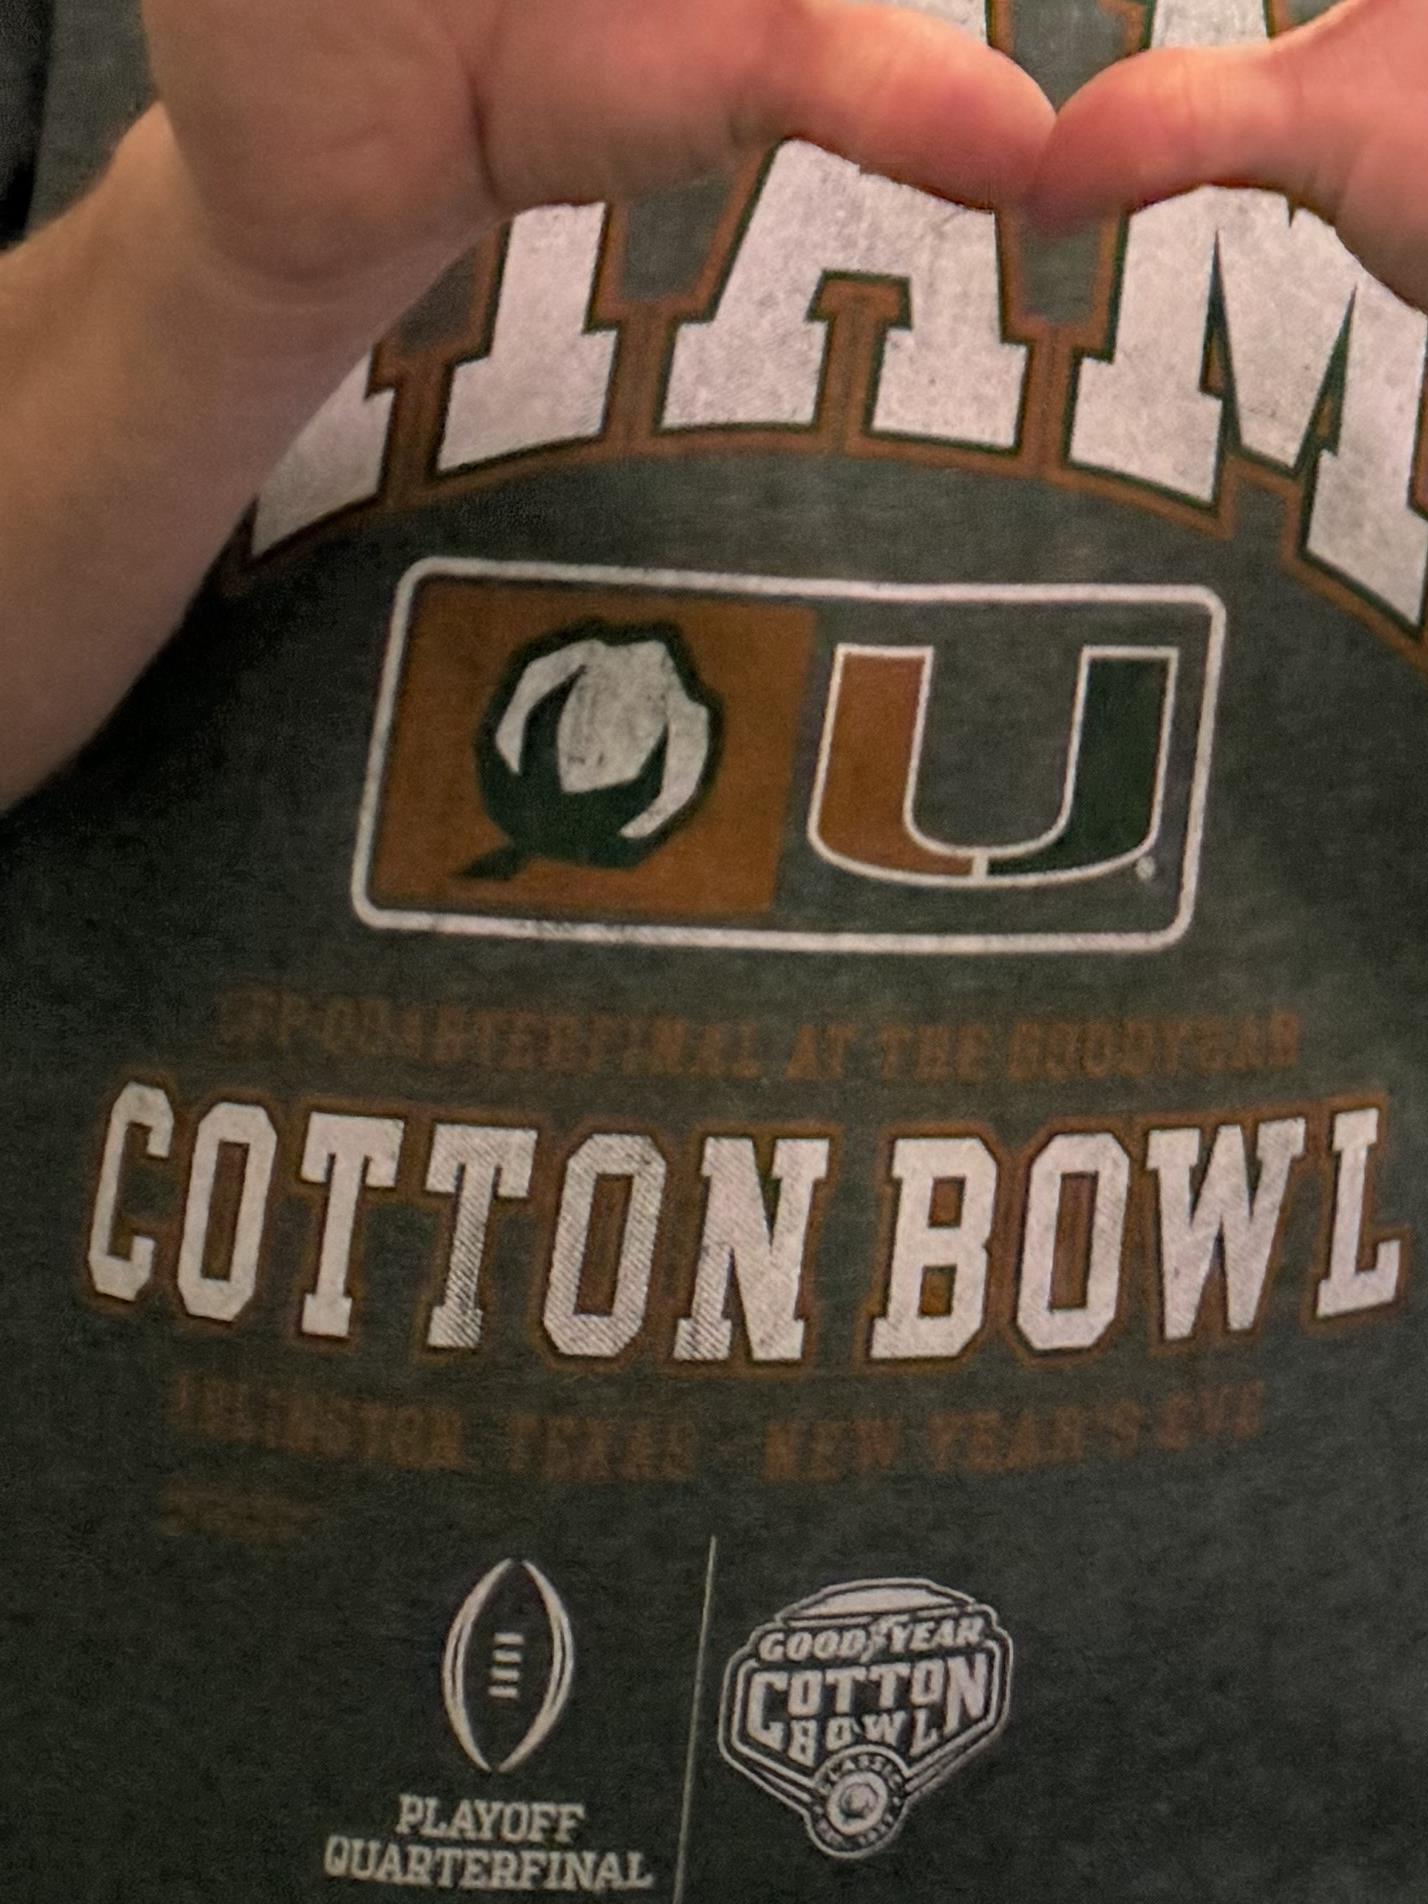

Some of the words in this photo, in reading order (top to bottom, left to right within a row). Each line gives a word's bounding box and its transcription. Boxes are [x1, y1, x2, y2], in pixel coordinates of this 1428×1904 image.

[807, 645, 1180, 886] U
[88, 1080, 830, 1362] COTTON
[869, 1107, 1402, 1360] BOWL
[757, 1616, 986, 1663] GOODYEAR
[747, 1653, 990, 1752] COTTON
[787, 1708, 939, 1768] BOWL
[396, 1793, 587, 1843] PLAYOFF
[323, 1835, 655, 1892] QUARTERFINAL
